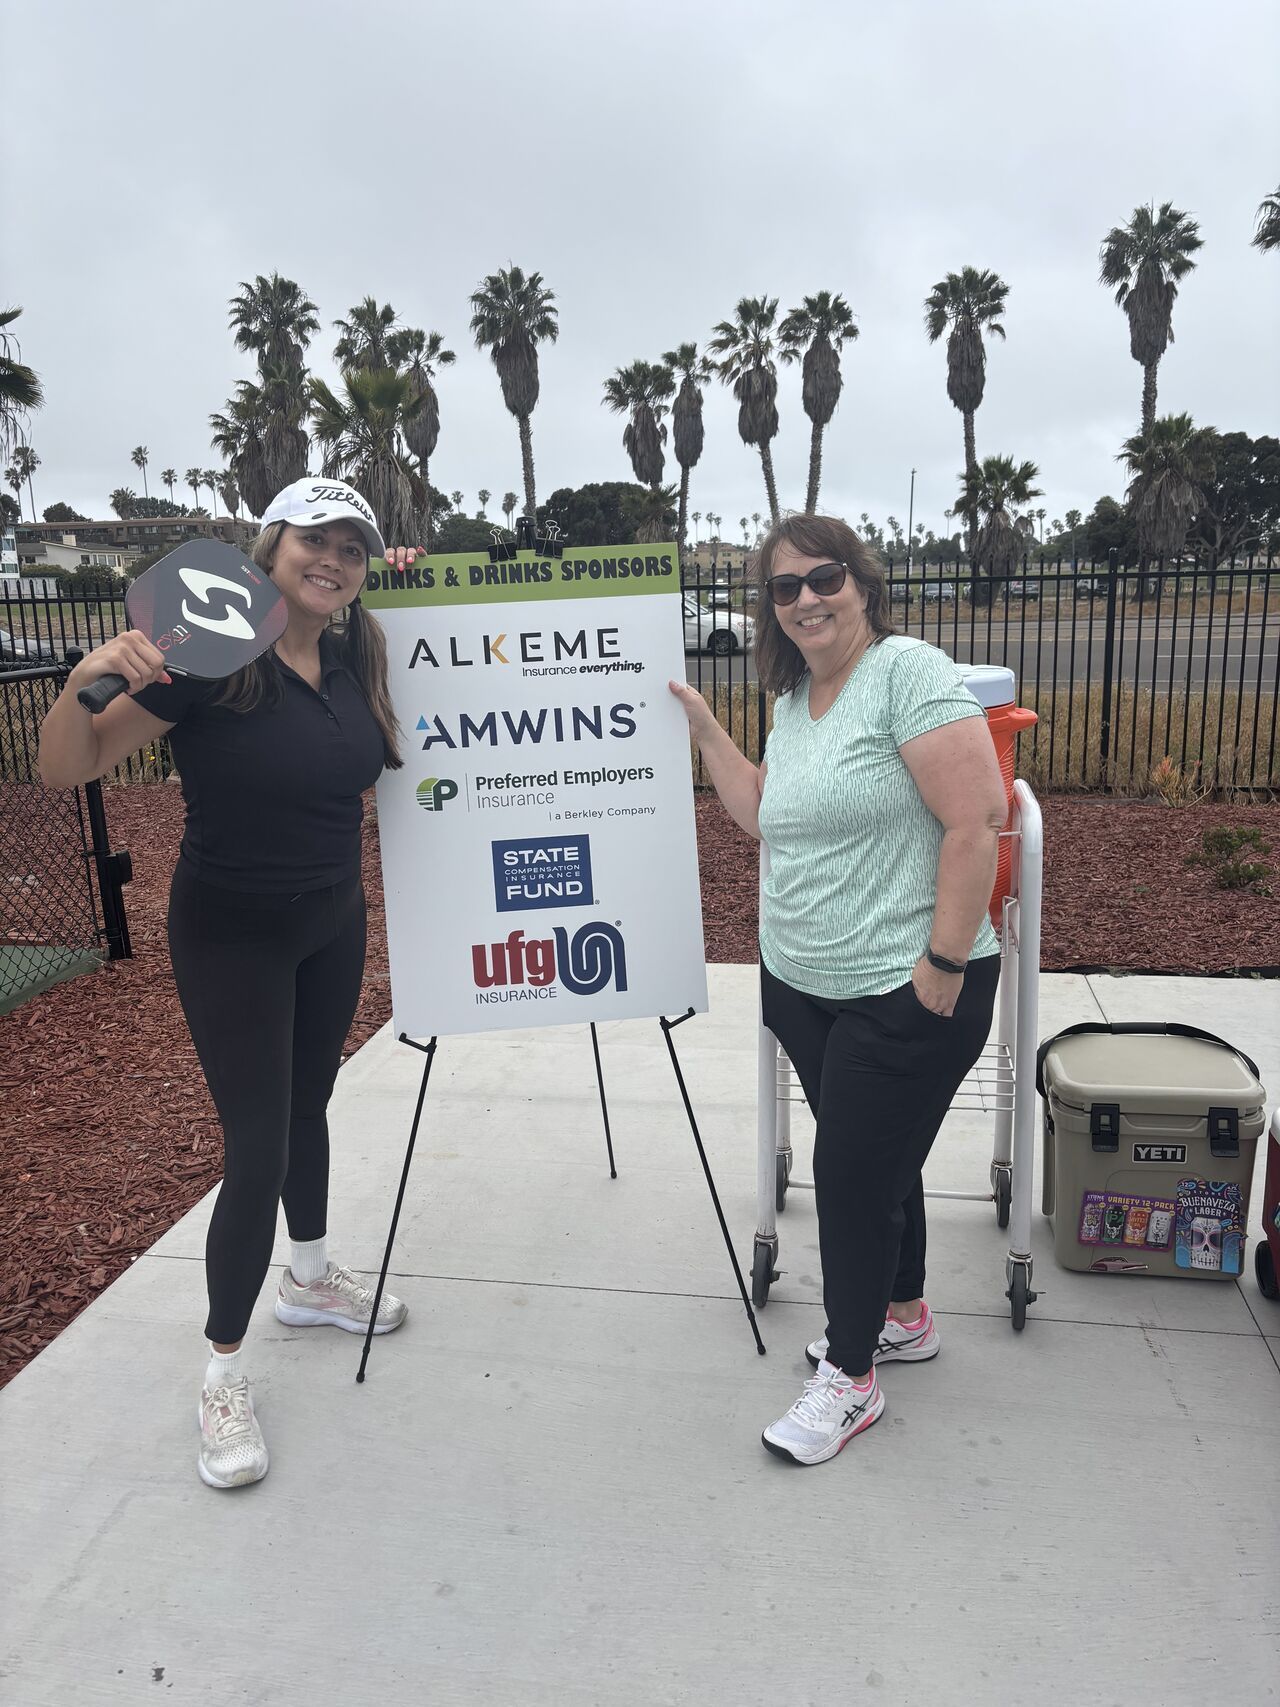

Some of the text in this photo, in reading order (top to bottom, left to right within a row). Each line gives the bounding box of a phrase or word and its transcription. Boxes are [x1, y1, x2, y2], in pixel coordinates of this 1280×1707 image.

[366, 555, 673, 592] DINKS & DRINKS SPONSORS
[408, 627, 622, 669] ALKEME
[522, 661, 646, 677] Insurance everything.
[416, 703, 637, 751] AMWINS
[475, 765, 654, 791] Preferred Employers
[477, 791, 555, 809] Insurance
[554, 805, 656, 820] a Berkley Company
[503, 846, 579, 866] STATE
[504, 864, 580, 875] COMPENSATION
[505, 871, 581, 882] INSURANCE
[506, 880, 584, 900] FUND
[471, 929, 557, 988] ufg
[475, 986, 558, 1005] INSURANCE
[1135, 1146, 1182, 1160] YETI
[1108, 1196, 1140, 1205] VARIETY
[1180, 1196, 1236, 1213] BUENAVEZA
[1194, 1206, 1222, 1217] LAGER
